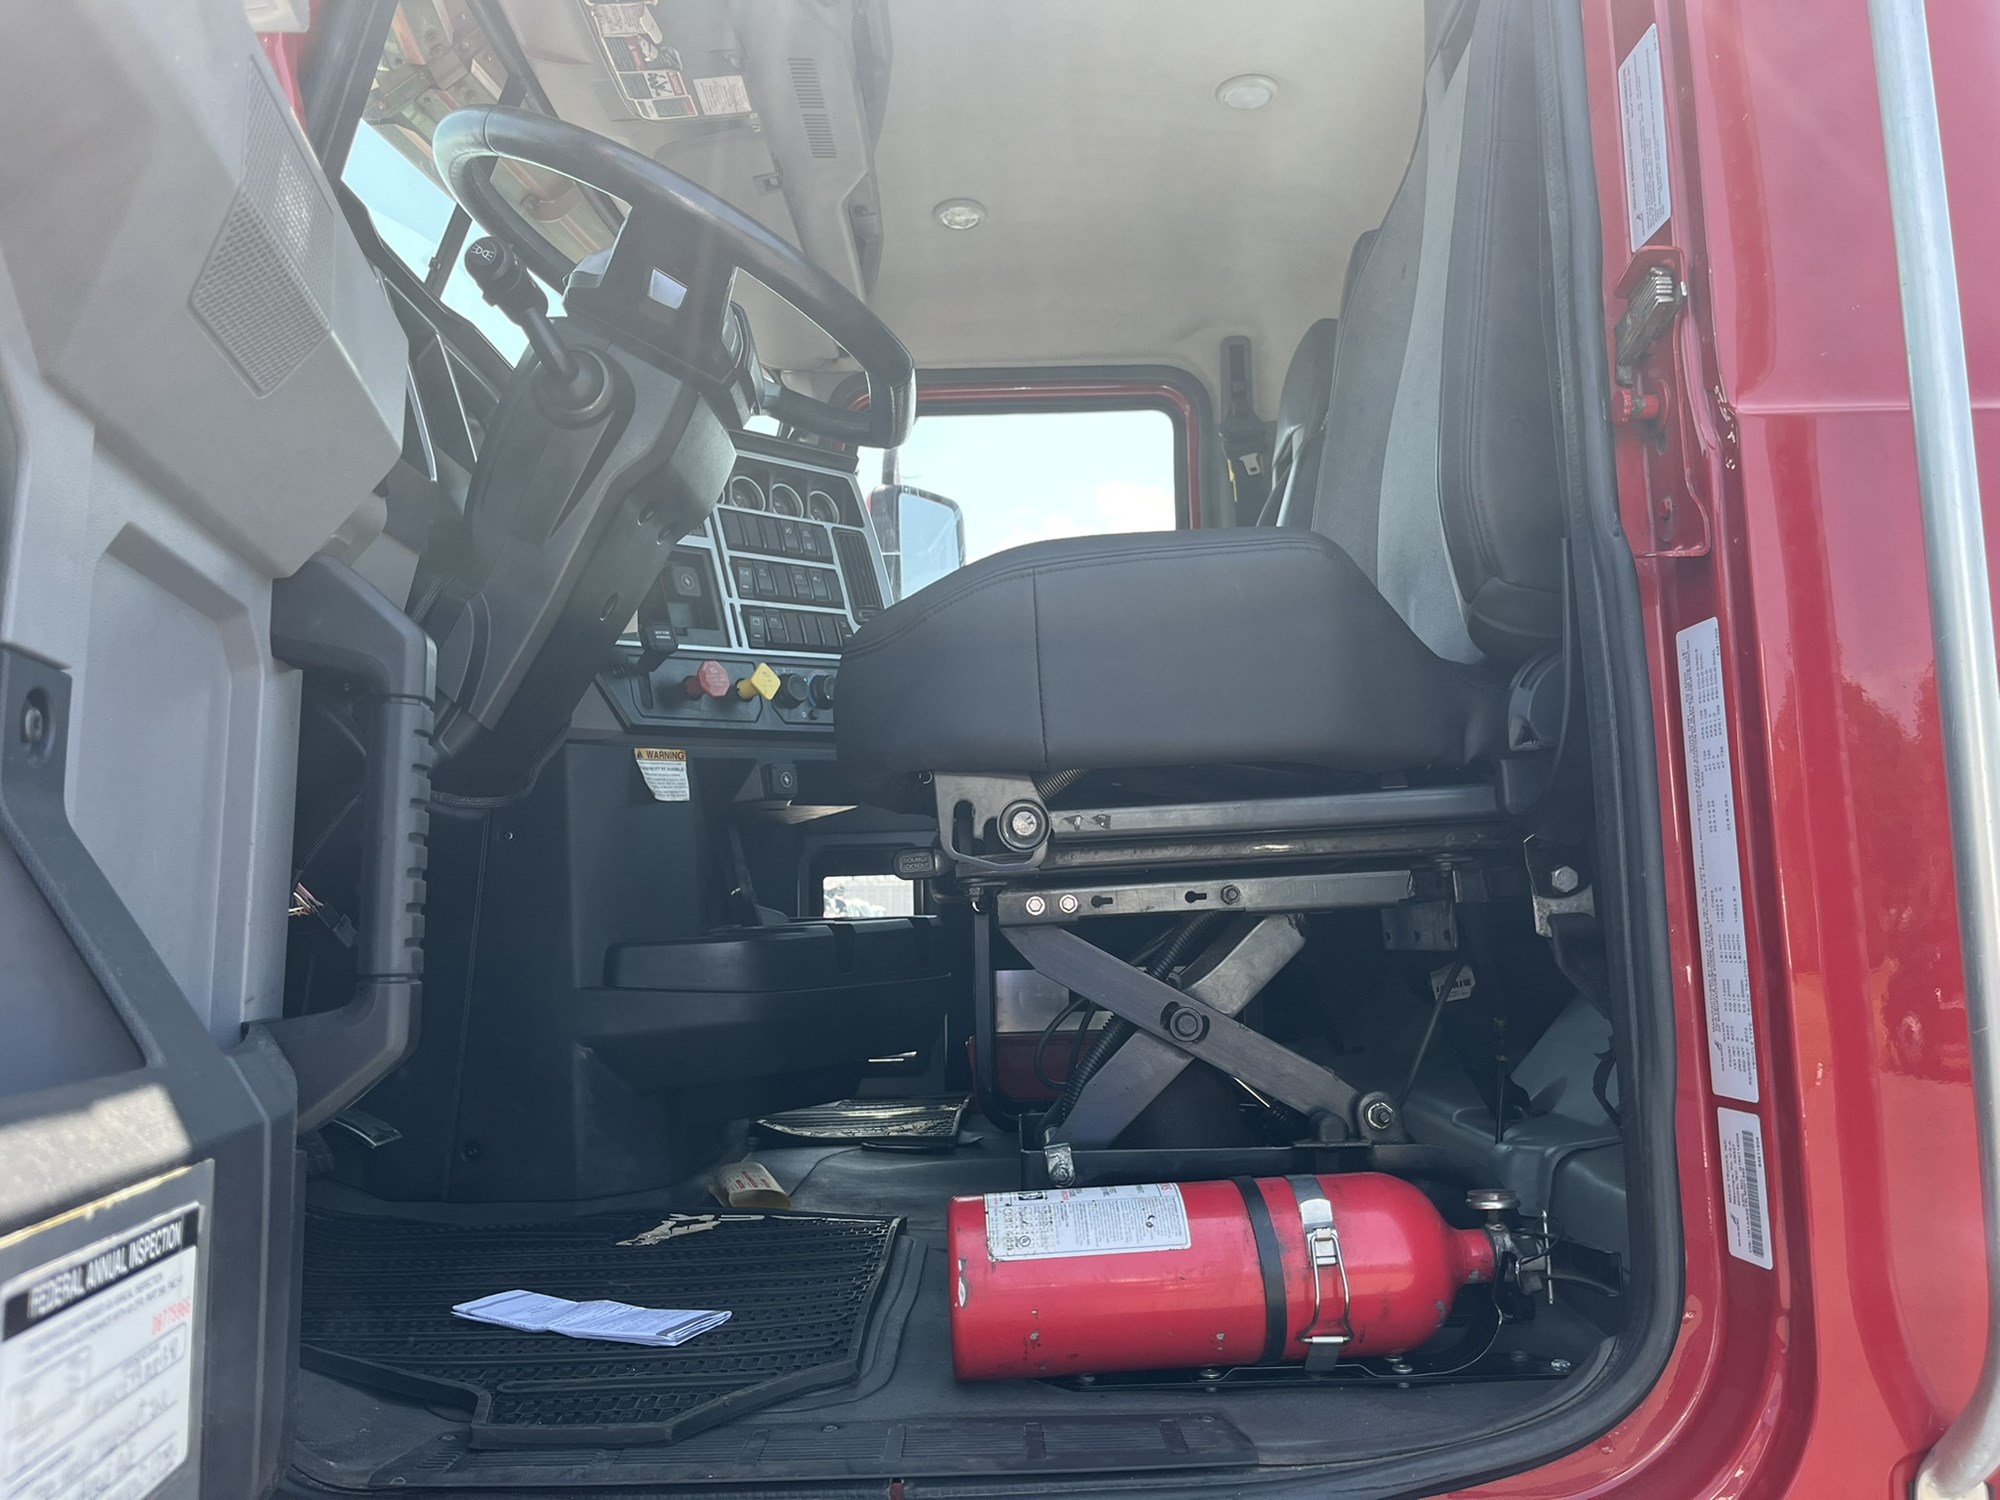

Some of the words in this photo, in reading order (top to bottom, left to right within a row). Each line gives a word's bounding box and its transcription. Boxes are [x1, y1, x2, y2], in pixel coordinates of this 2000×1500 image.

[646, 750, 685, 760] WARNING
[28, 1264, 86, 1319] FEDERAL
[86, 1246, 129, 1287] ANNUAL
[129, 1220, 182, 1270] INSPECTION
